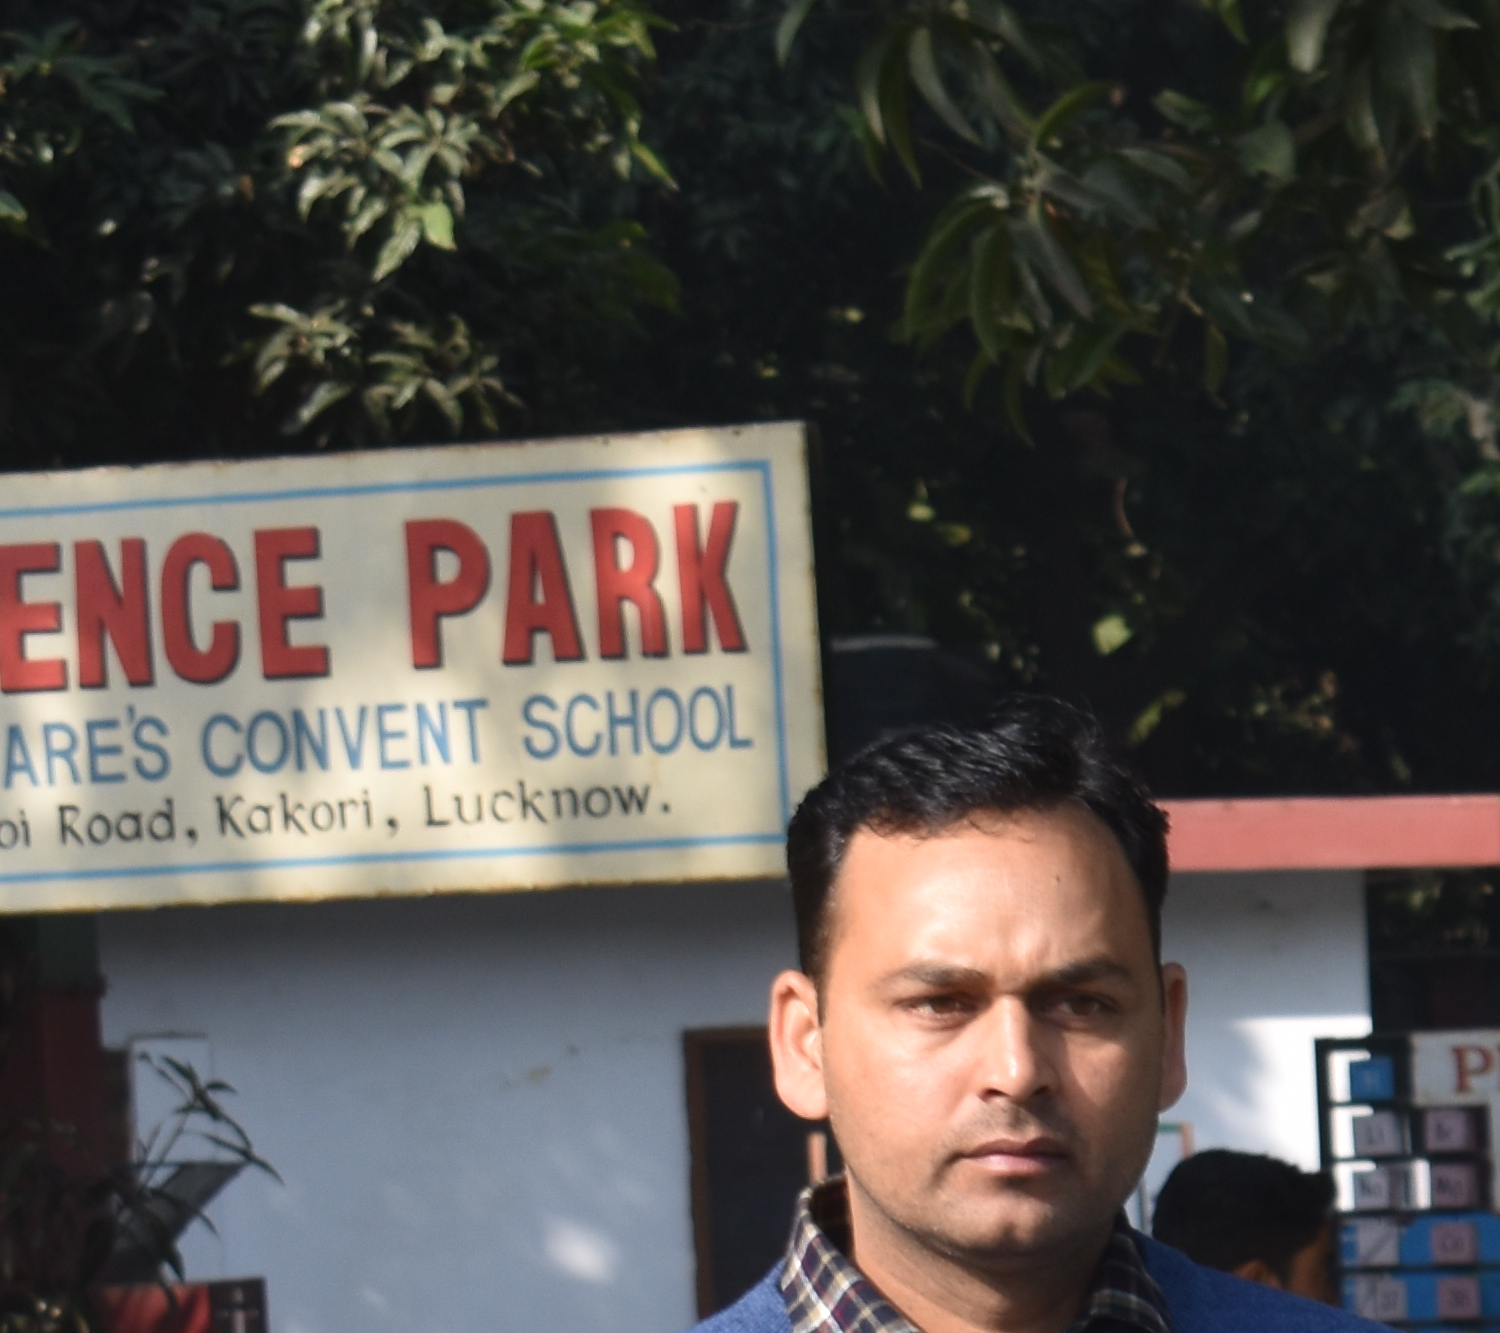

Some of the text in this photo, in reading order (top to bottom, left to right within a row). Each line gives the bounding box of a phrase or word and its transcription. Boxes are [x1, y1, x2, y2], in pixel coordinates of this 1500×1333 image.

[0, 499, 748, 692] ENCE PARK
[4, 683, 753, 790] ARE'S CONVENT SCHOOL
[58, 796, 199, 846] Road,
[214, 787, 398, 837] Kakori,
[422, 779, 671, 826] Lucknow.
